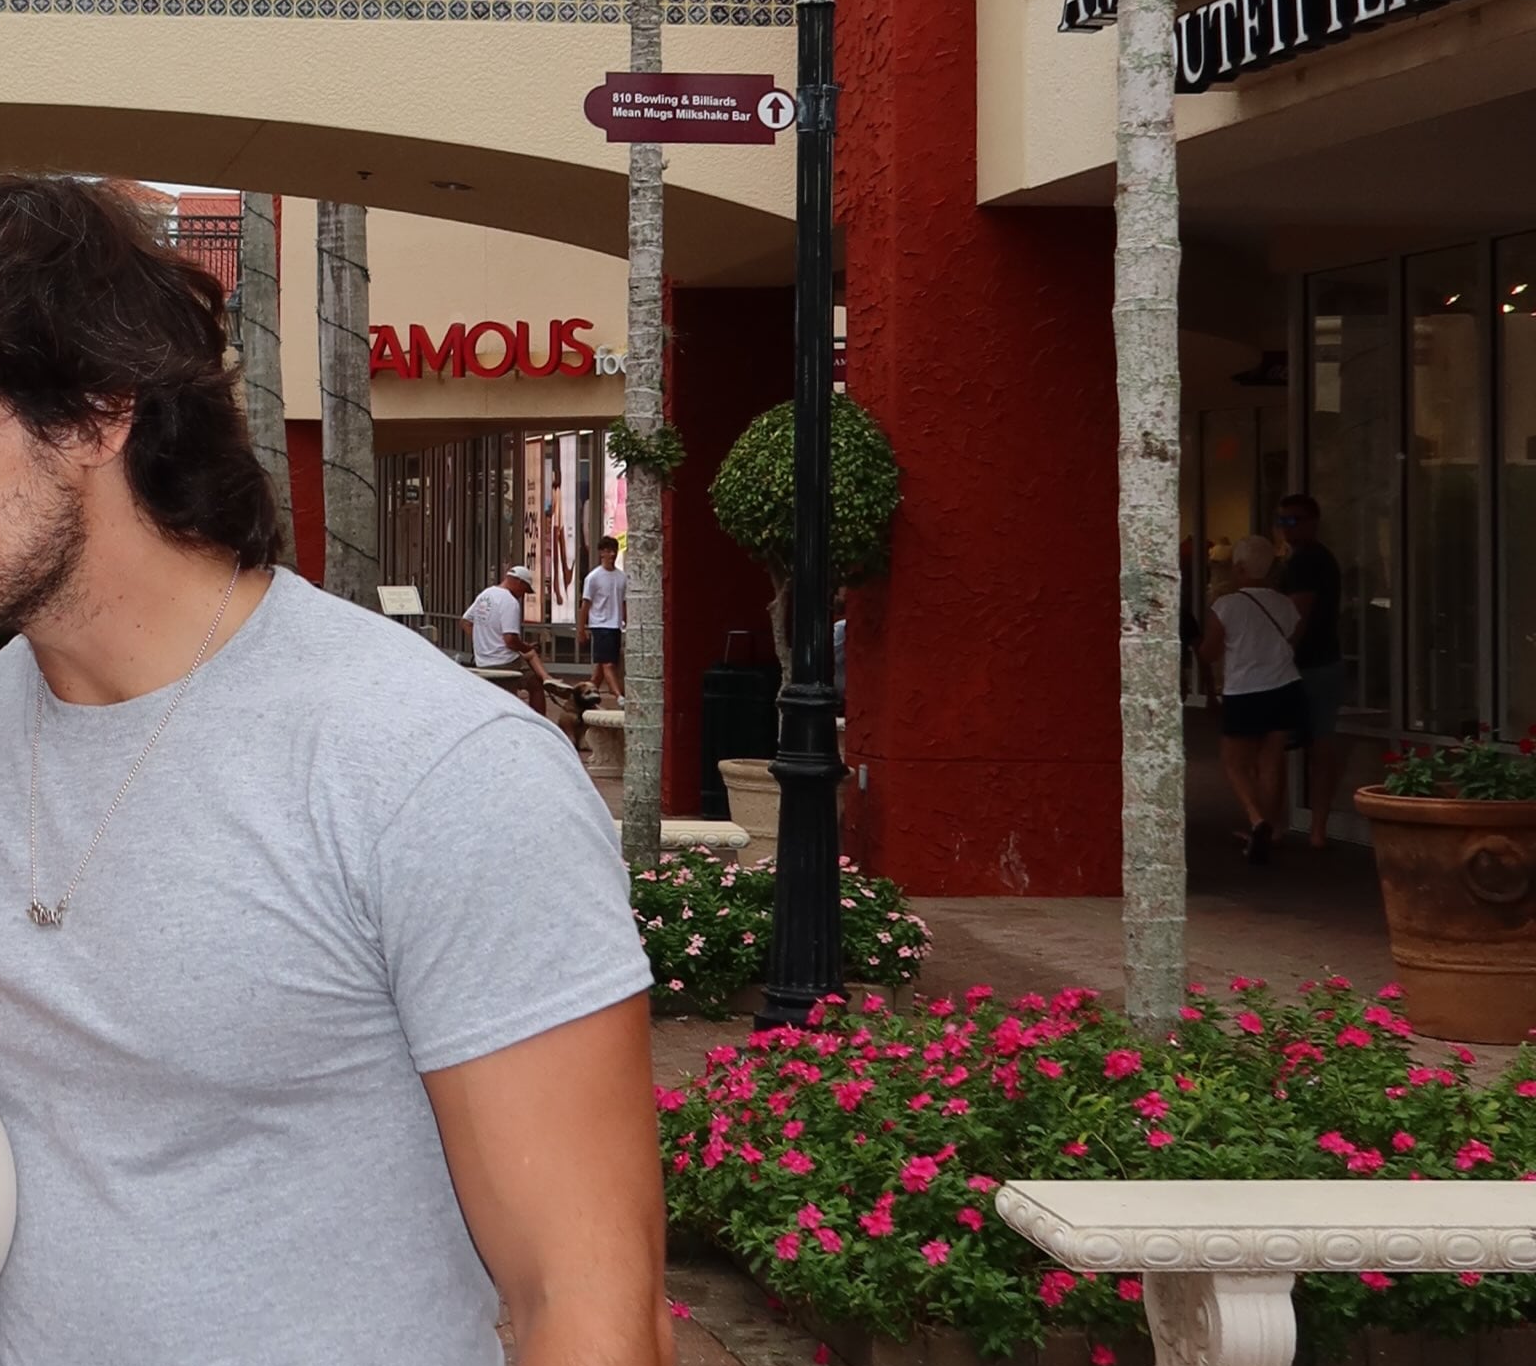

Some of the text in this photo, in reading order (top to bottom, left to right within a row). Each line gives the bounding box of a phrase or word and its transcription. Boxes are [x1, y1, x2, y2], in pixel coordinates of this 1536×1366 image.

[612, 93, 737, 107] 810 Bowling & Billiards
[612, 107, 752, 122] Mean Mugs Milkshake Bar
[368, 317, 594, 380] AMOUS
